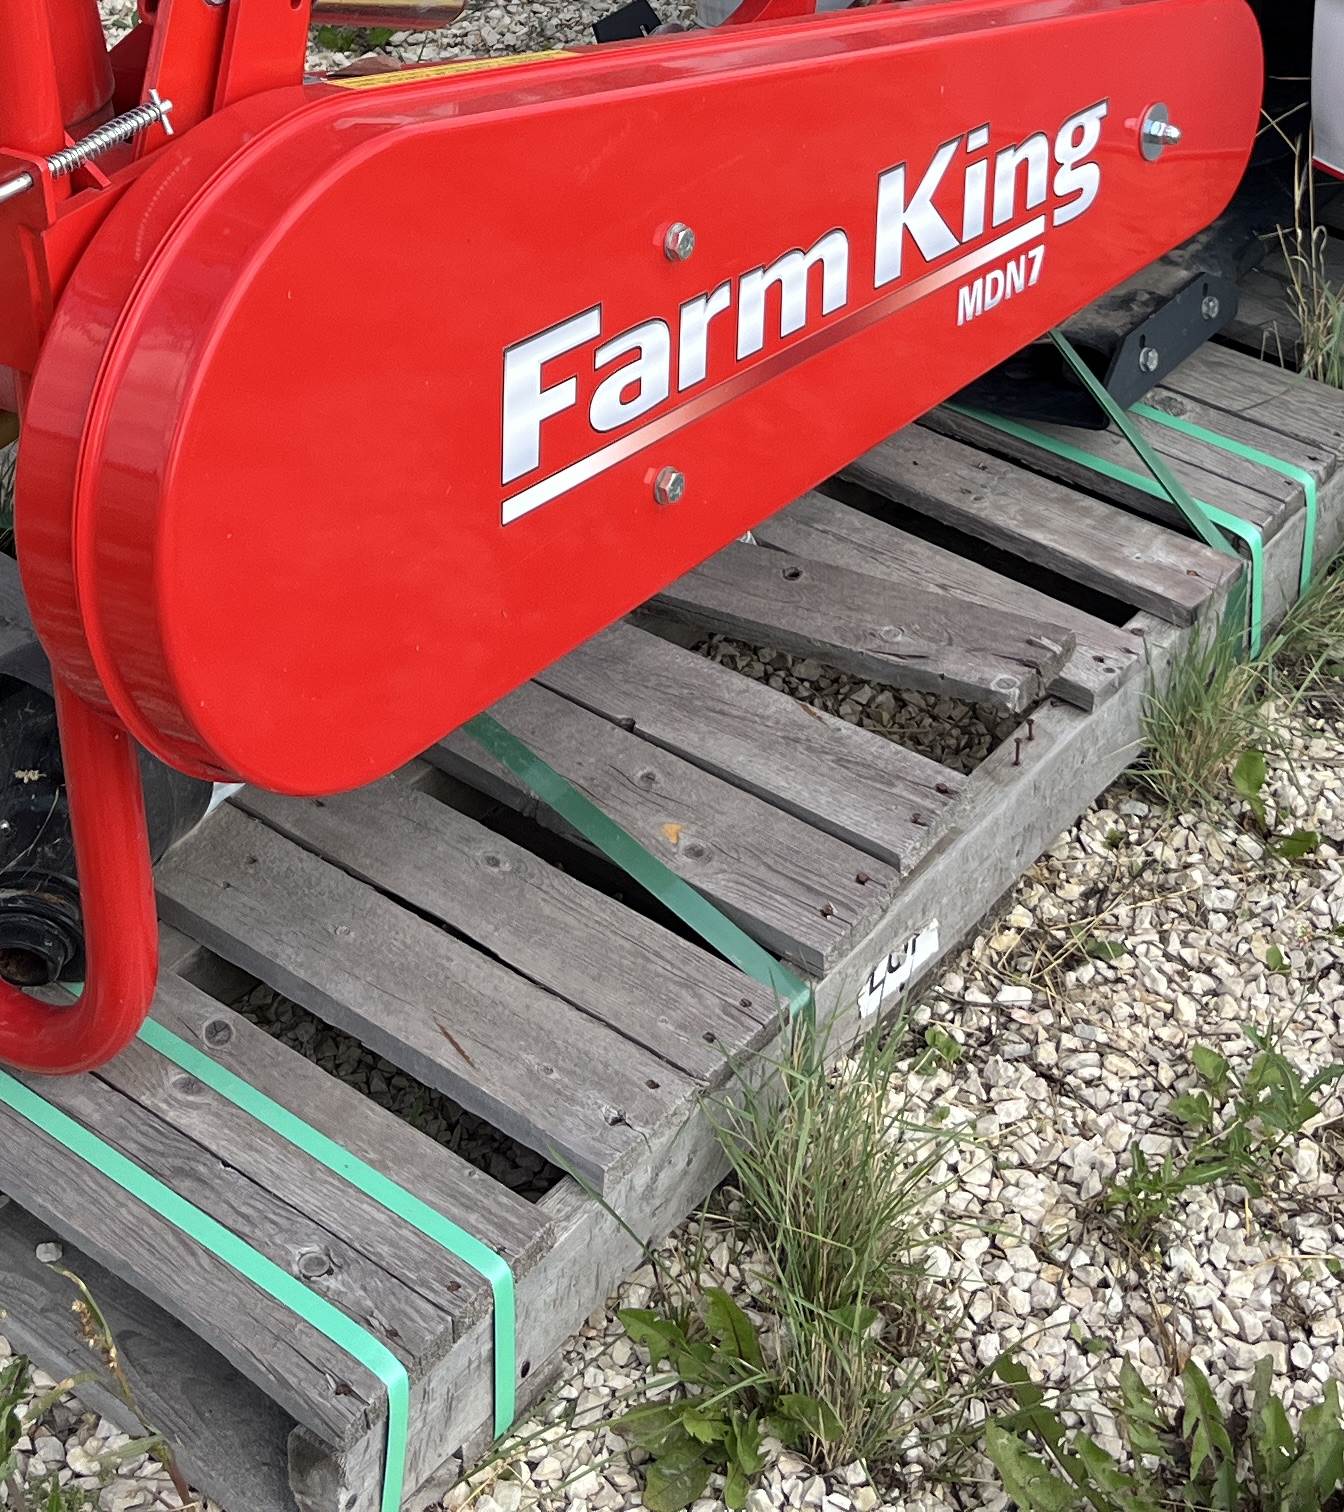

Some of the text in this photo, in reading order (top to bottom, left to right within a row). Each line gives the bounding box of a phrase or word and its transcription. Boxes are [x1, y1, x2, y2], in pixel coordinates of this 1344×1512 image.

[501, 96, 1110, 486] Farm King
[956, 244, 1046, 326] MDN7
